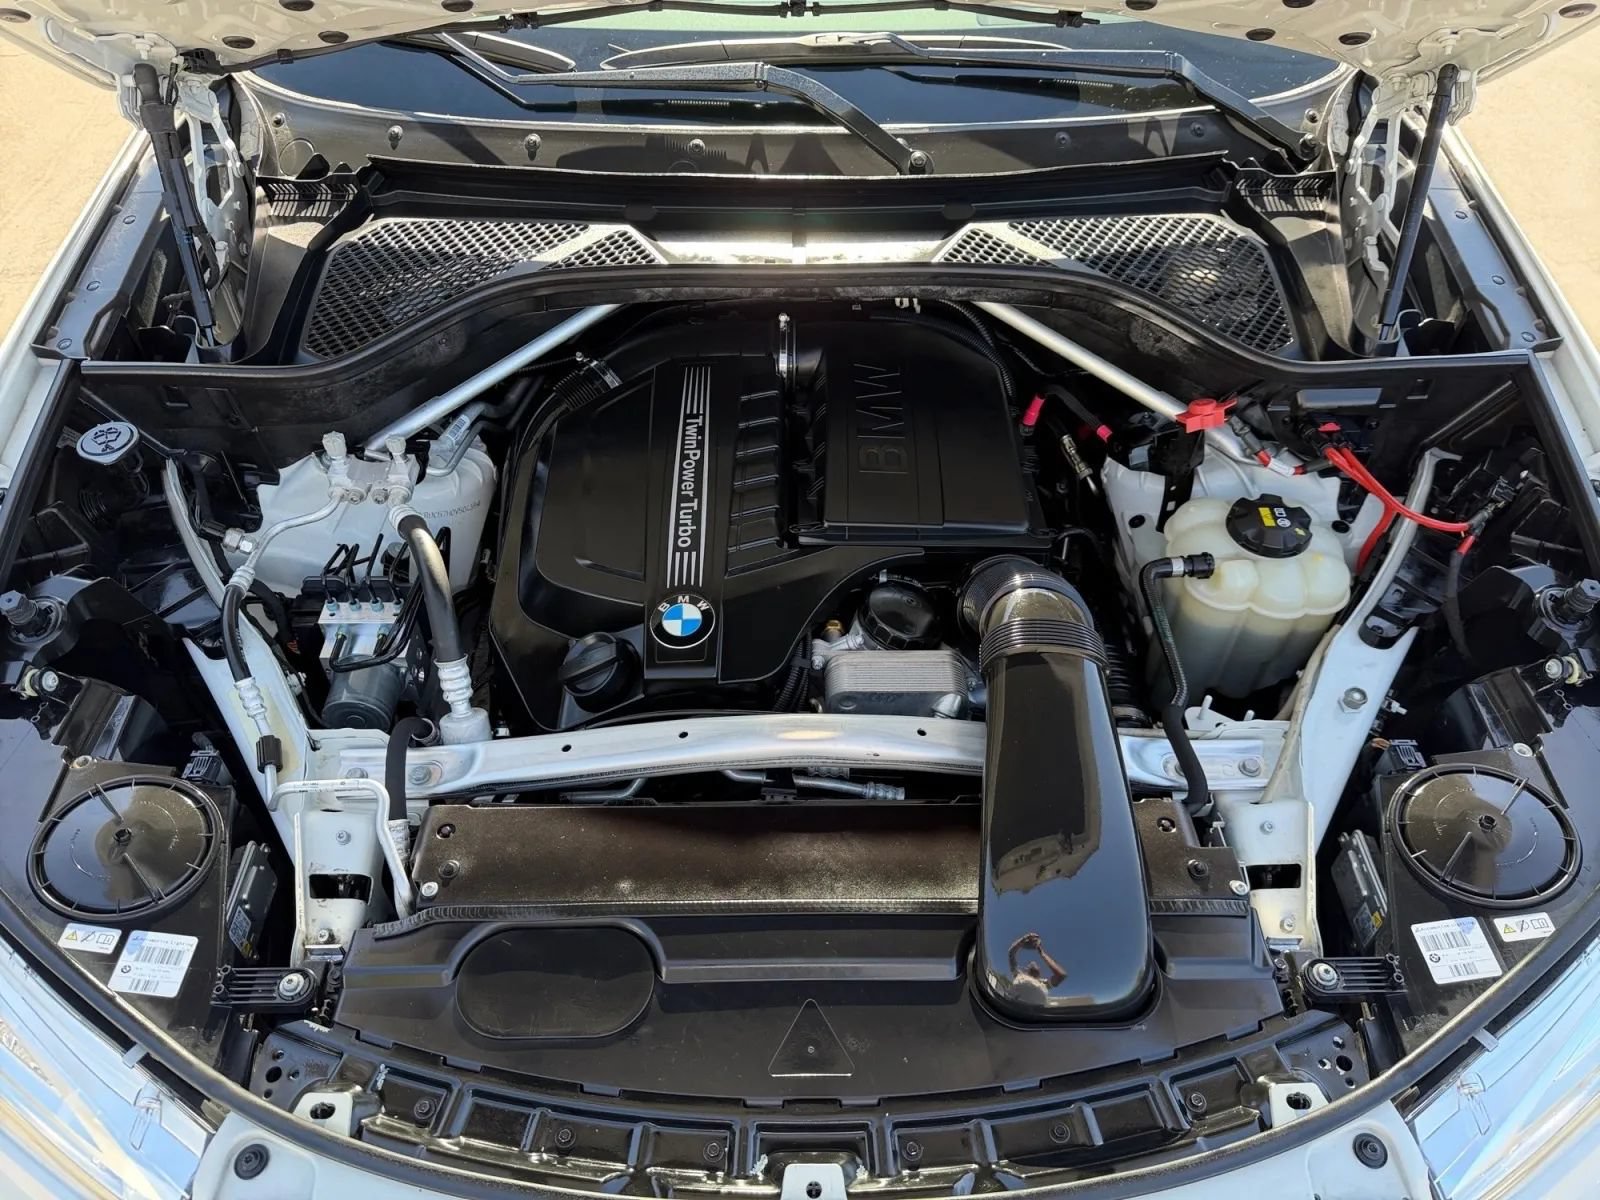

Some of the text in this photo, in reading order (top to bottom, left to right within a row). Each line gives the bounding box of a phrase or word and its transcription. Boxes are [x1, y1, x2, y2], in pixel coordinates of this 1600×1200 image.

[853, 363, 908, 474] BMW
[677, 415, 702, 548] TwinPower Turbo
[657, 595, 710, 613] BMW
